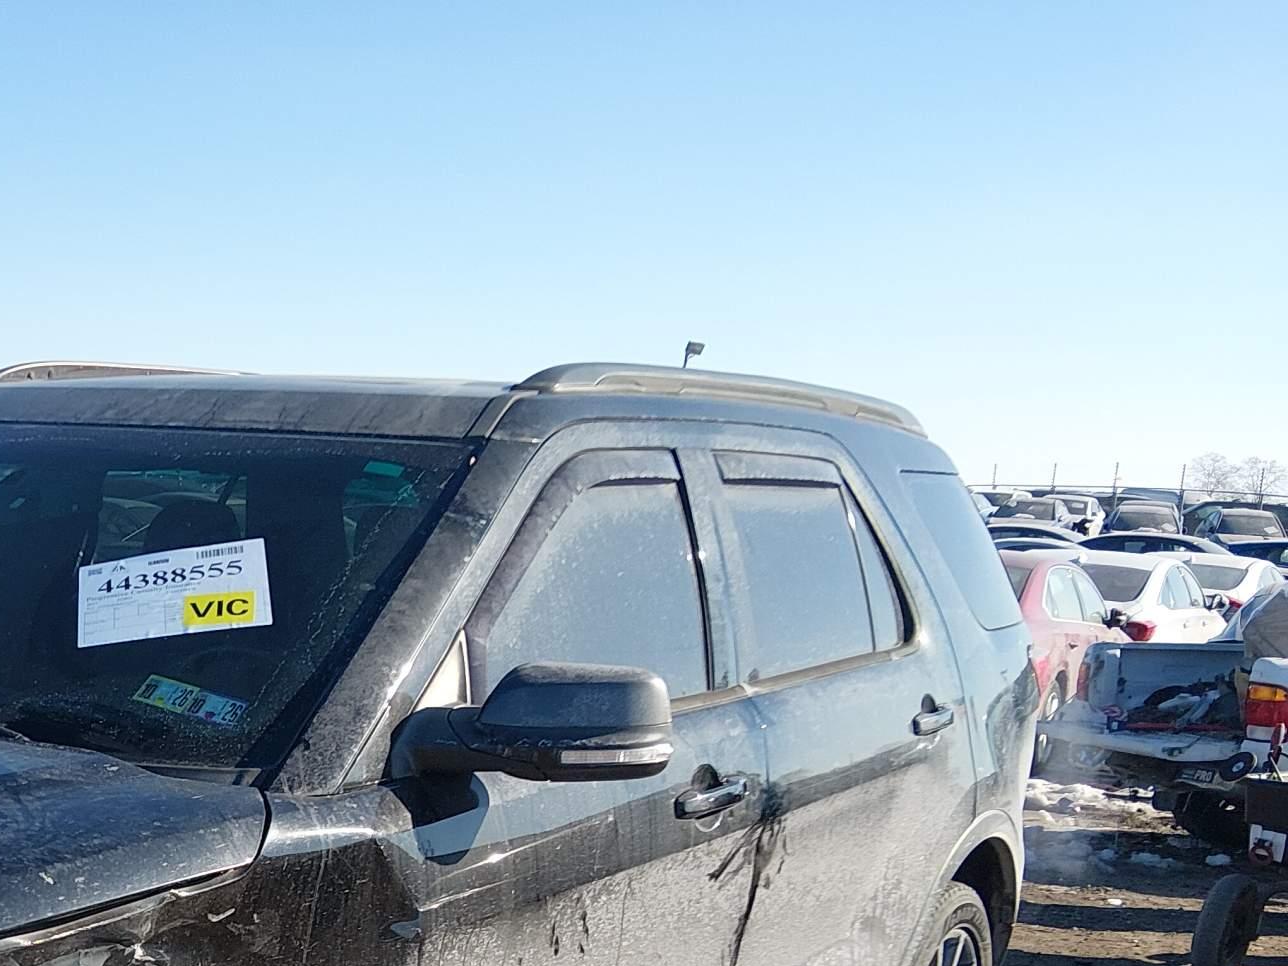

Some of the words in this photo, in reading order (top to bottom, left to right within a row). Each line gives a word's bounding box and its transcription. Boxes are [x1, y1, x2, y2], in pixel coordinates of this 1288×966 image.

[97, 559, 243, 593] 44388555
[189, 599, 249, 618] VIC
[171, 688, 193, 707] 26
